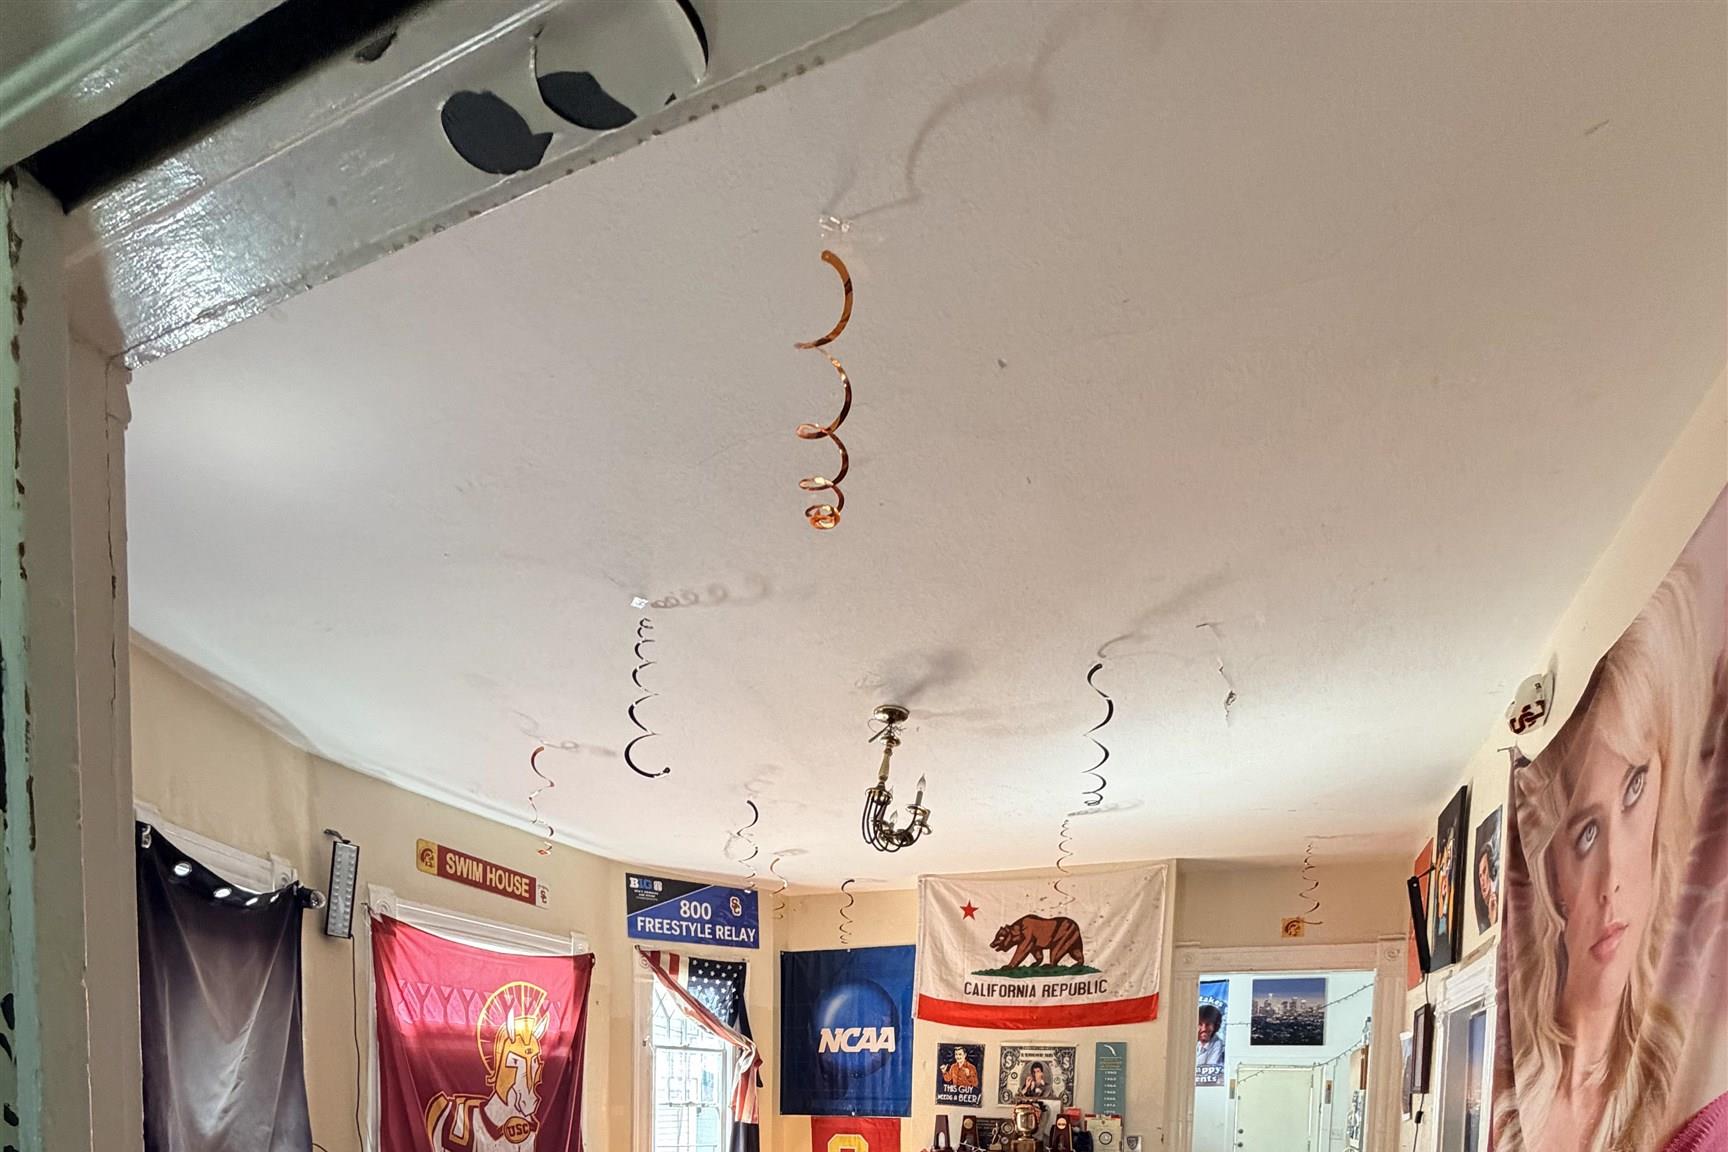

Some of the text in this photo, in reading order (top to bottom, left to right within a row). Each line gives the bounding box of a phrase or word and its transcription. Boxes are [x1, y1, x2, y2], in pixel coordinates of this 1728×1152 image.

[446, 852, 530, 898] SWIM HOUSE
[680, 900, 712, 920] 800
[637, 916, 756, 942] FREESTYLE RELAY
[964, 979, 1108, 998] CALIFORNIA REPUBLIC
[818, 1026, 896, 1053] NCAA
[943, 1084, 974, 1094] THIS GUY
[958, 1093, 982, 1105] BEER!
[507, 1123, 529, 1137] USC
